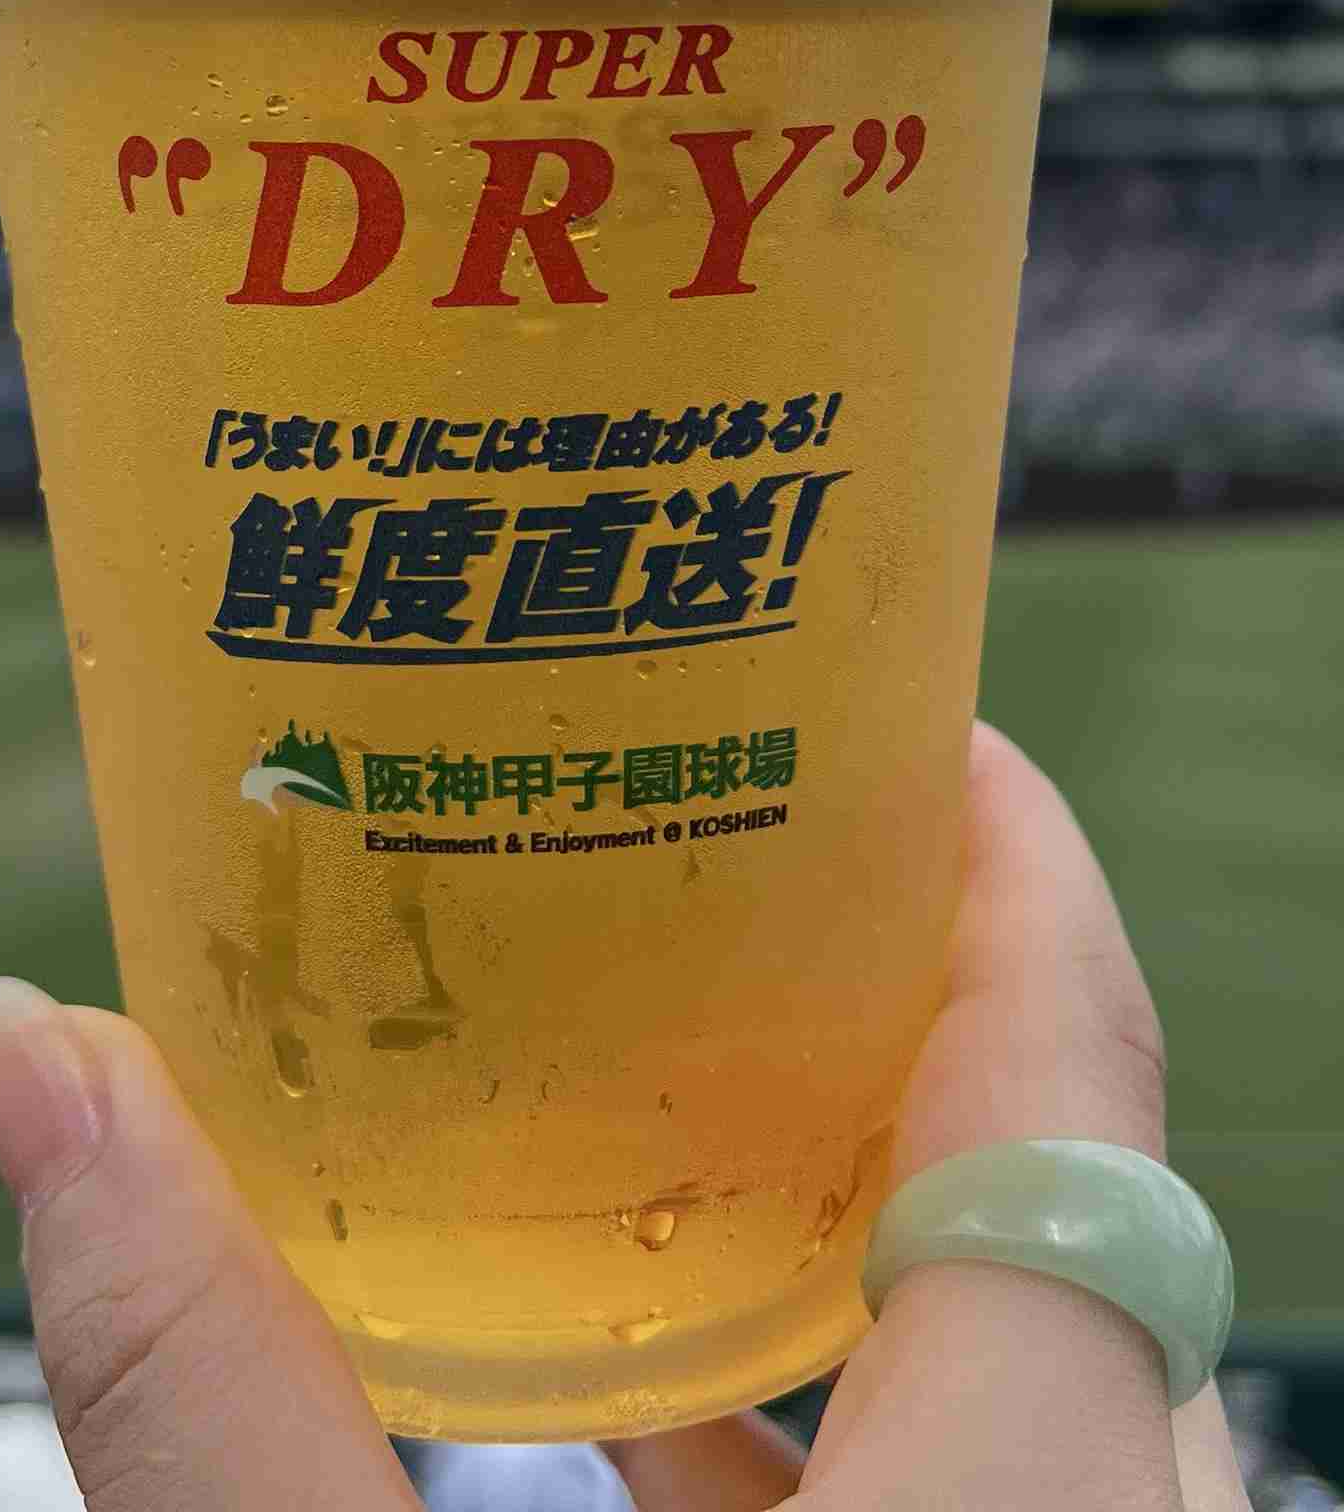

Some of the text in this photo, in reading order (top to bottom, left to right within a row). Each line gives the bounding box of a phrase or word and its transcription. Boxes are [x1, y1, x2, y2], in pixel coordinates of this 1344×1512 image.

[367, 23, 734, 105] SUPER
[213, 470, 854, 644] 鮮度直送!
[362, 726, 799, 816] 阪神甲子園球場
[365, 804, 788, 854] Excitement & Enjoyment @ KOSHIEN
